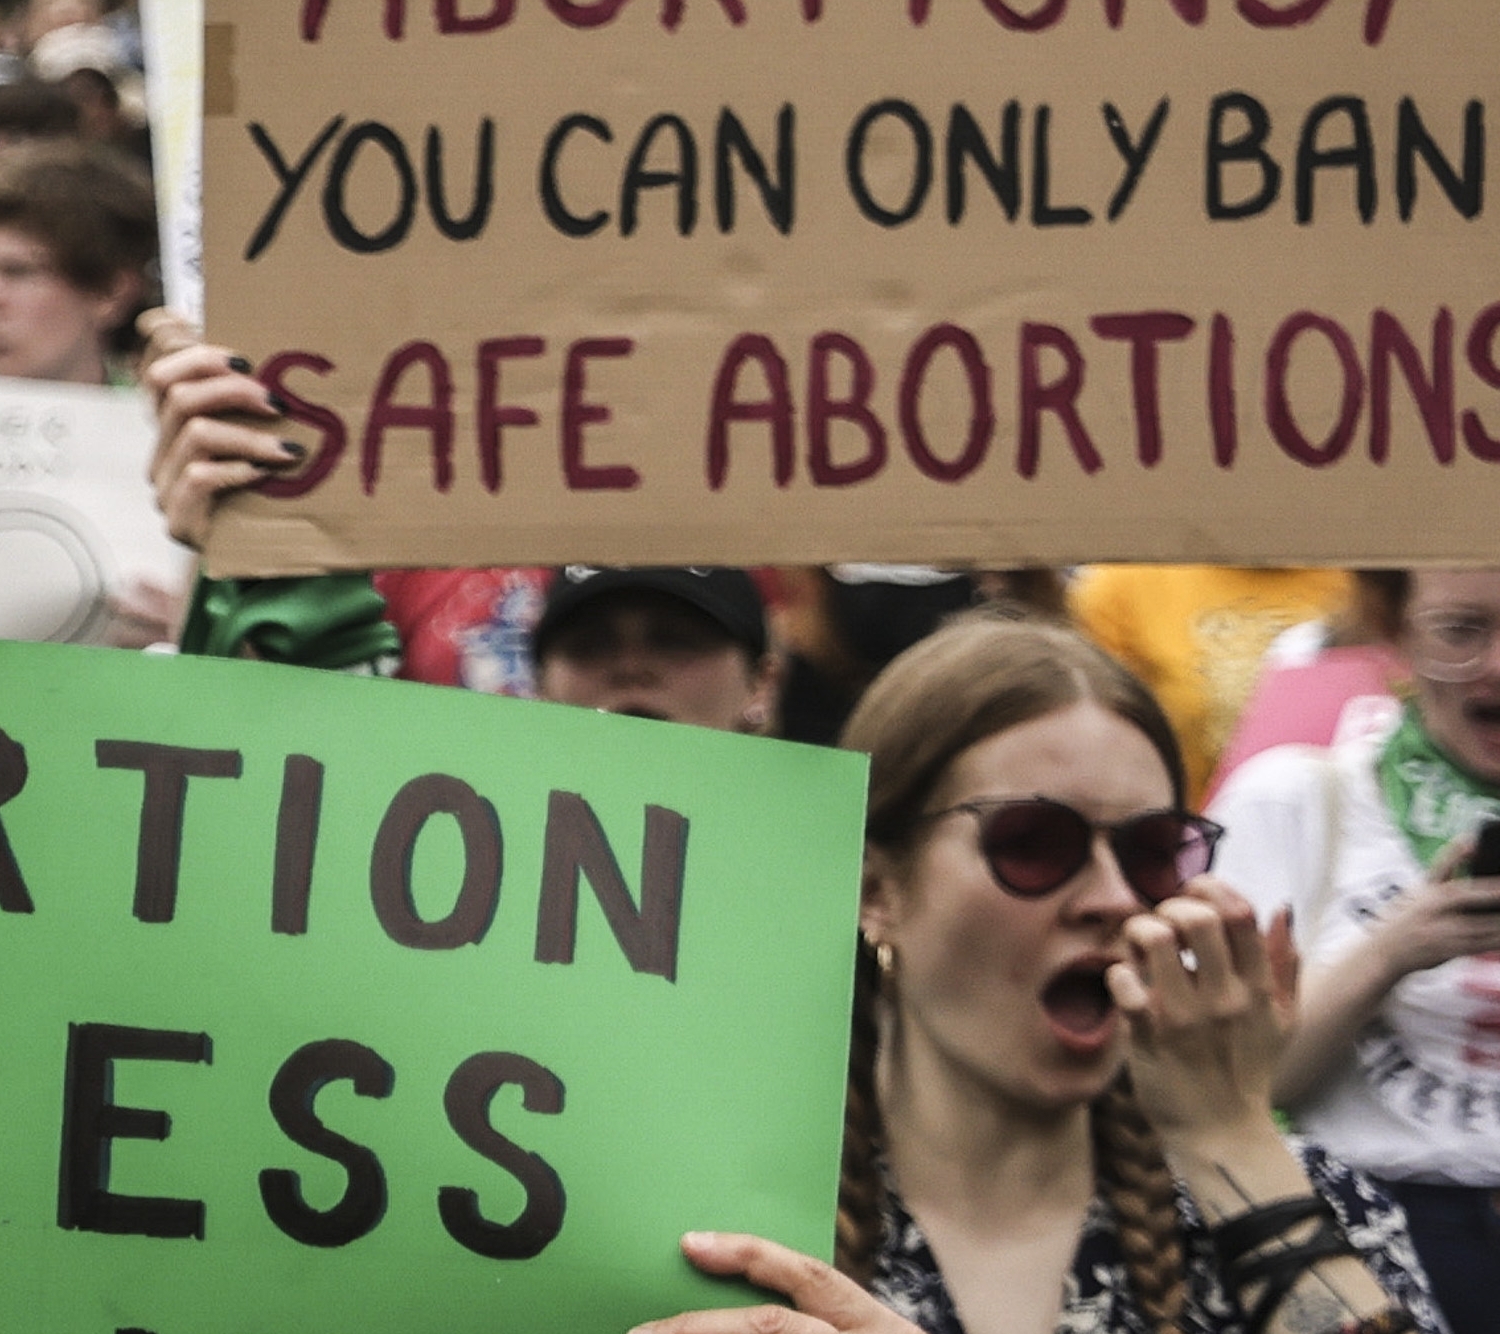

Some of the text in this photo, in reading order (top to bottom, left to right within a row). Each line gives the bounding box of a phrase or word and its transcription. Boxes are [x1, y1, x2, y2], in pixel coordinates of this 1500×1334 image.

[244, 110, 495, 263] YOU
[537, 98, 797, 239] CAN
[844, 93, 1172, 227] ONLY
[1205, 89, 1486, 225] BAN
[252, 335, 642, 498] SAFE
[706, 304, 1500, 491] ABORTIONS
